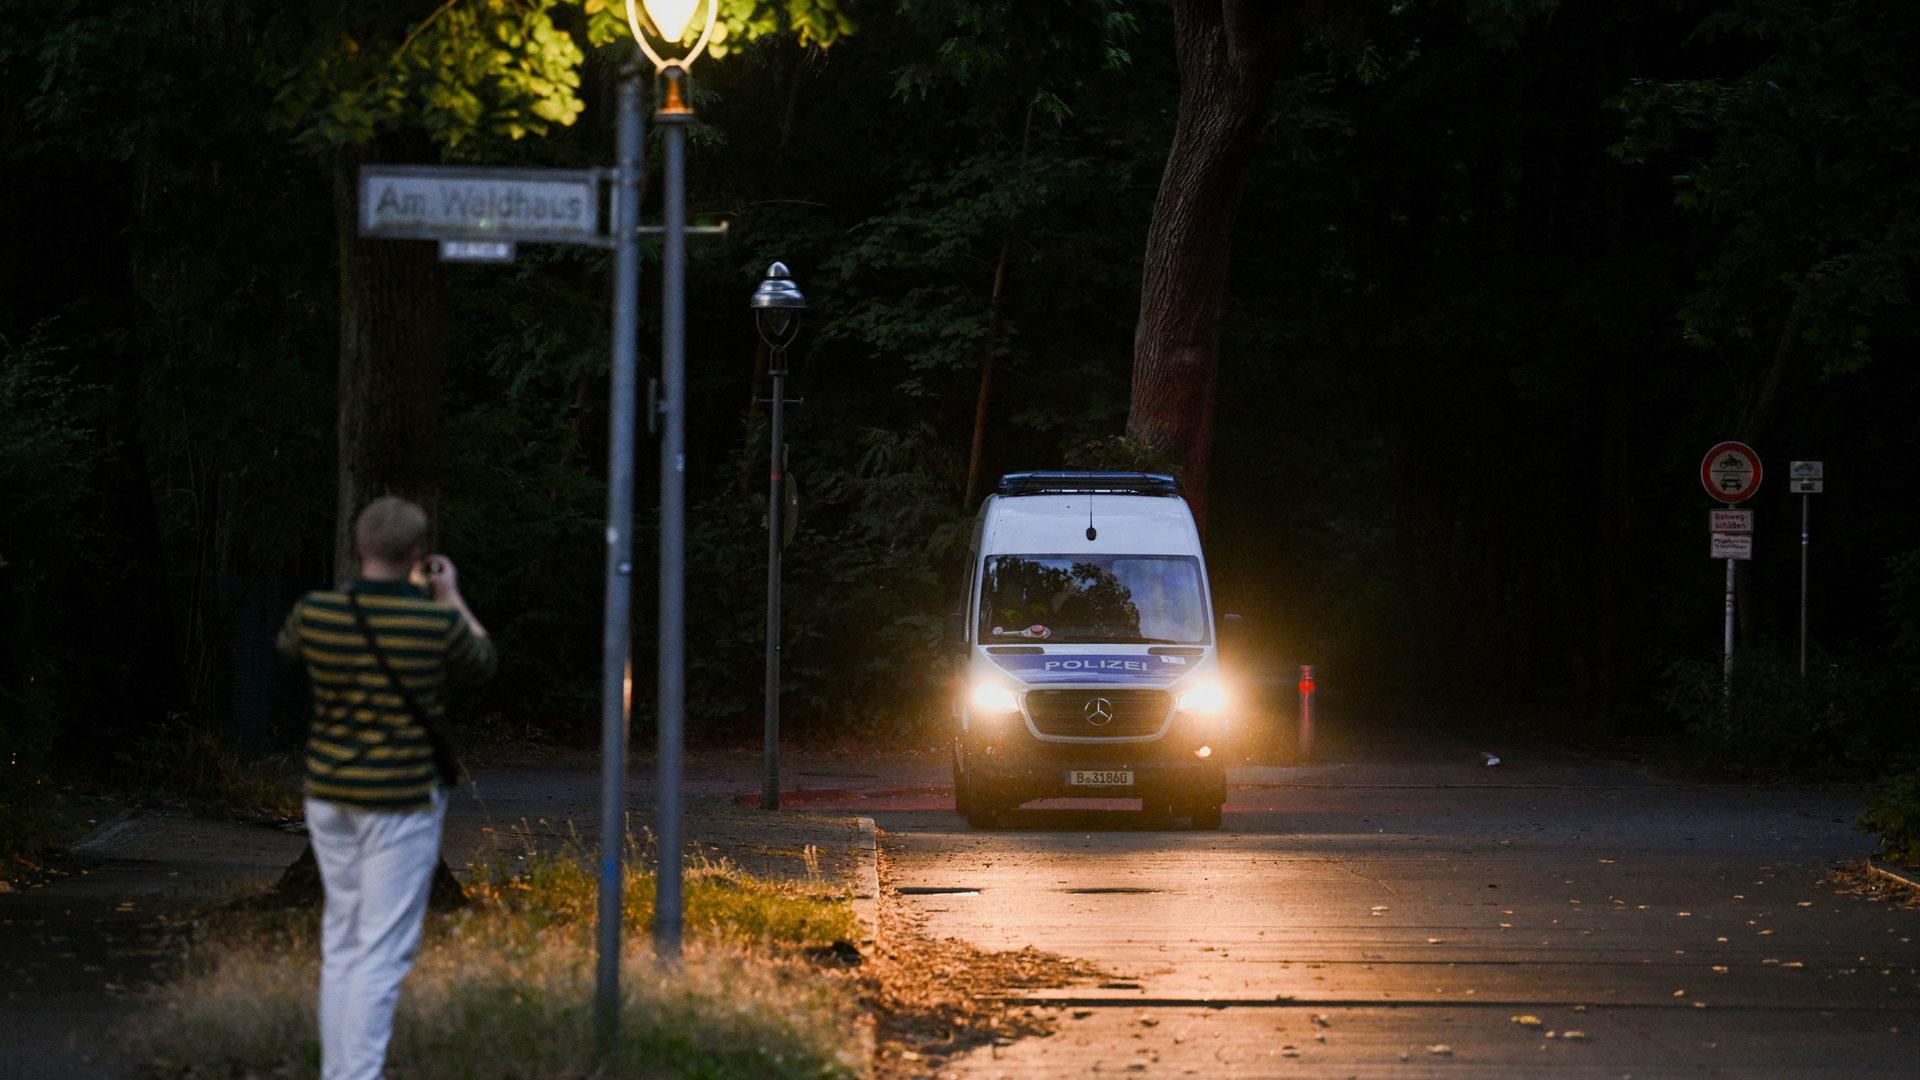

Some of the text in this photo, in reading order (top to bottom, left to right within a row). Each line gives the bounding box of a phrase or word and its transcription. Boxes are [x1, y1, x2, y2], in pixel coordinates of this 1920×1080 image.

[375, 184, 582, 220] Am Waldhaus
[1045, 660, 1148, 672] POLIZEI
[1076, 772, 1127, 784] B 31860
